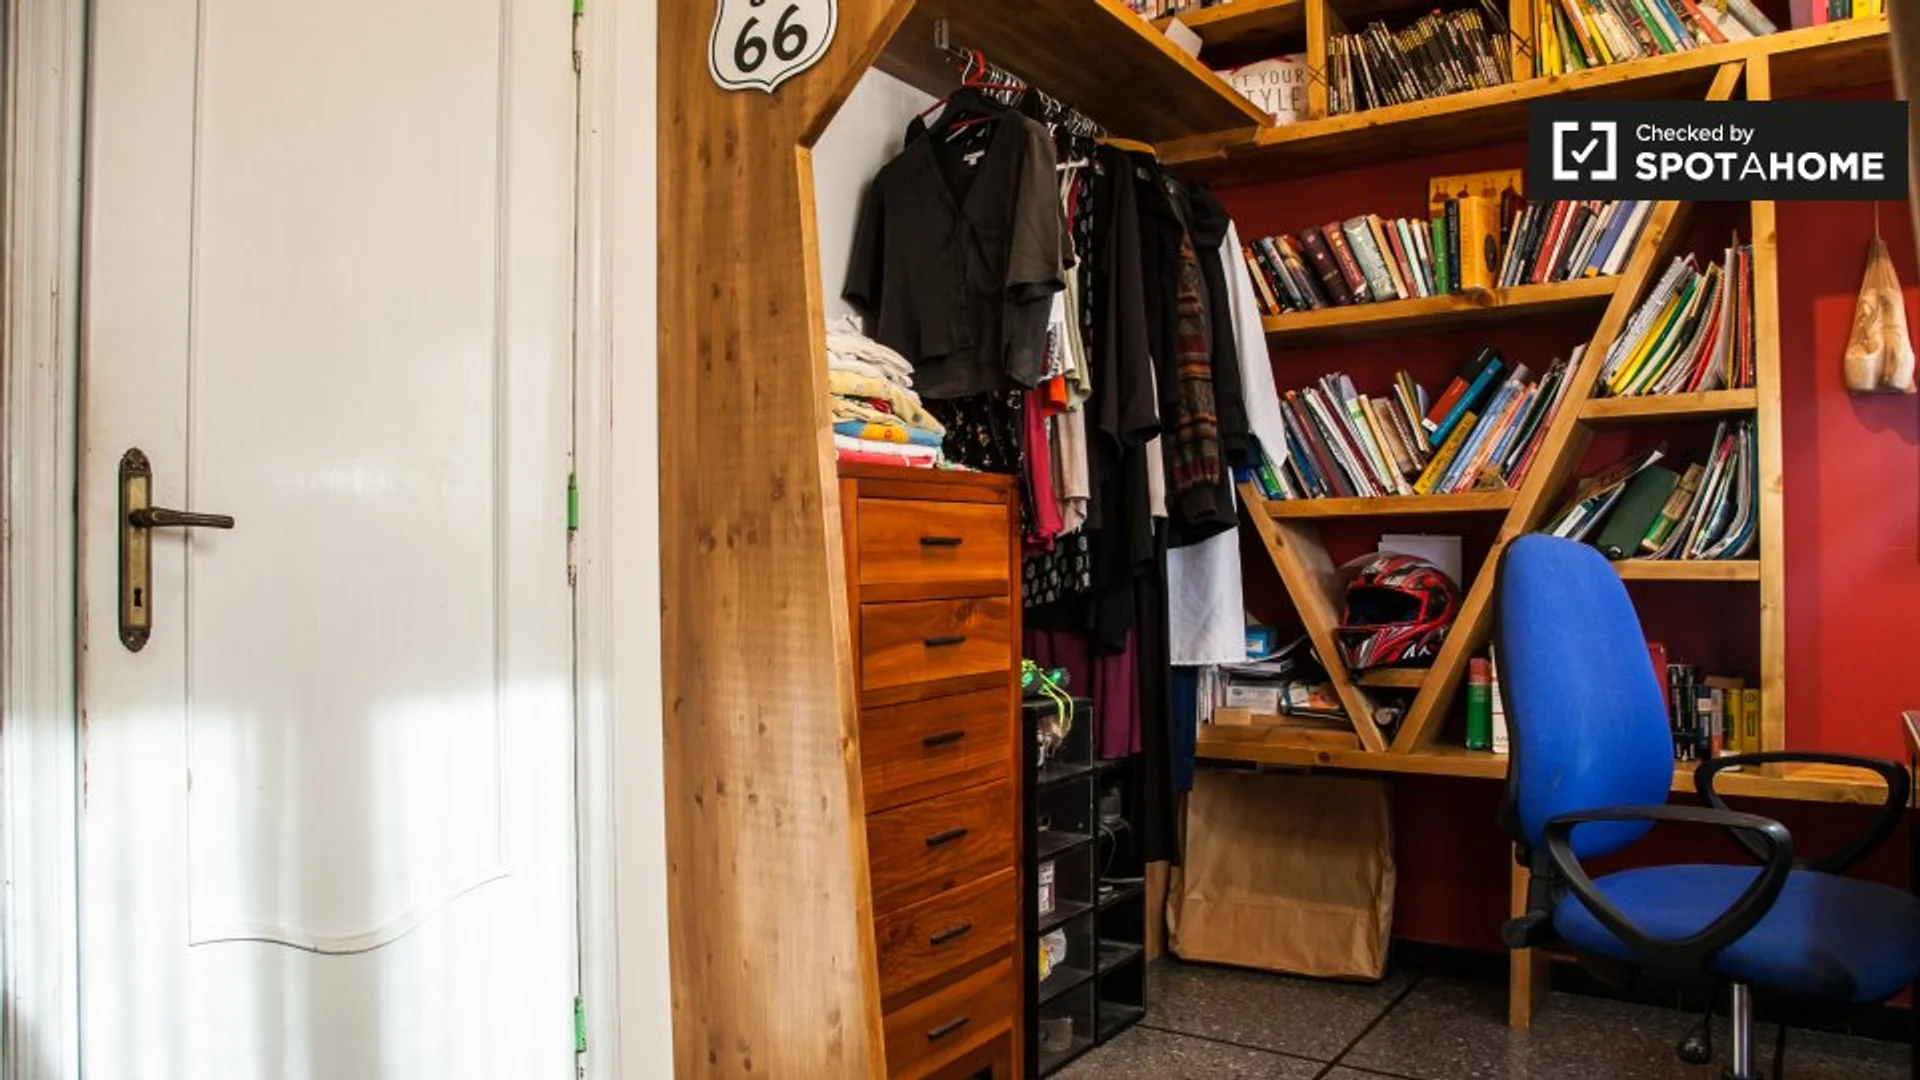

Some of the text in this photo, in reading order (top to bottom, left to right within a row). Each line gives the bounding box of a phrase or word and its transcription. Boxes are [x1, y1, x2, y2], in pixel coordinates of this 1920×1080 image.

[734, 3, 808, 73] 66
[1232, 68, 1304, 88] ET YOUR
[1244, 86, 1301, 112] TYLE
